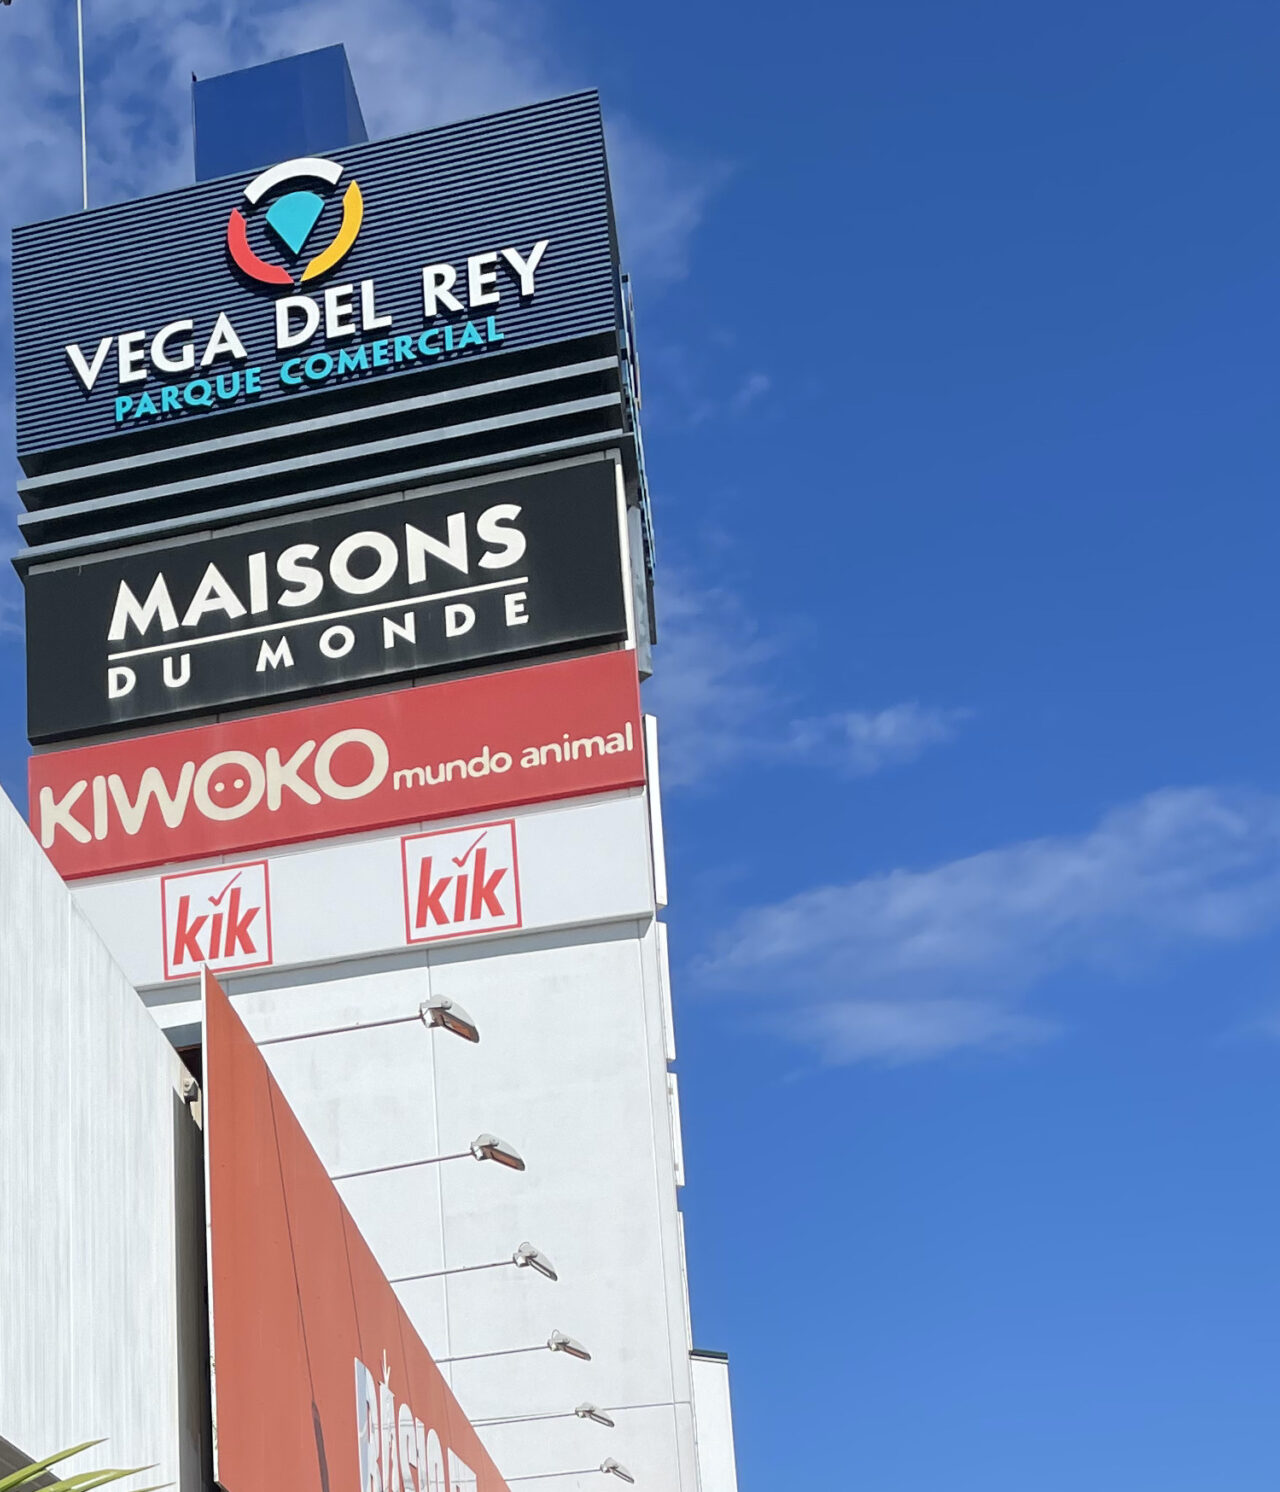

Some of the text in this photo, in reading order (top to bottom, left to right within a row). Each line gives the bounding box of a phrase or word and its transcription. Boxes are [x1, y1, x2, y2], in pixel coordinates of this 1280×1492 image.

[65, 239, 550, 391] VEGA DEL REY
[114, 316, 505, 422] PARQUE COMERCIAL
[107, 504, 527, 641] MAISONS
[107, 591, 529, 699] DU MONDE
[39, 722, 634, 849] KIWOKO mundo animal
